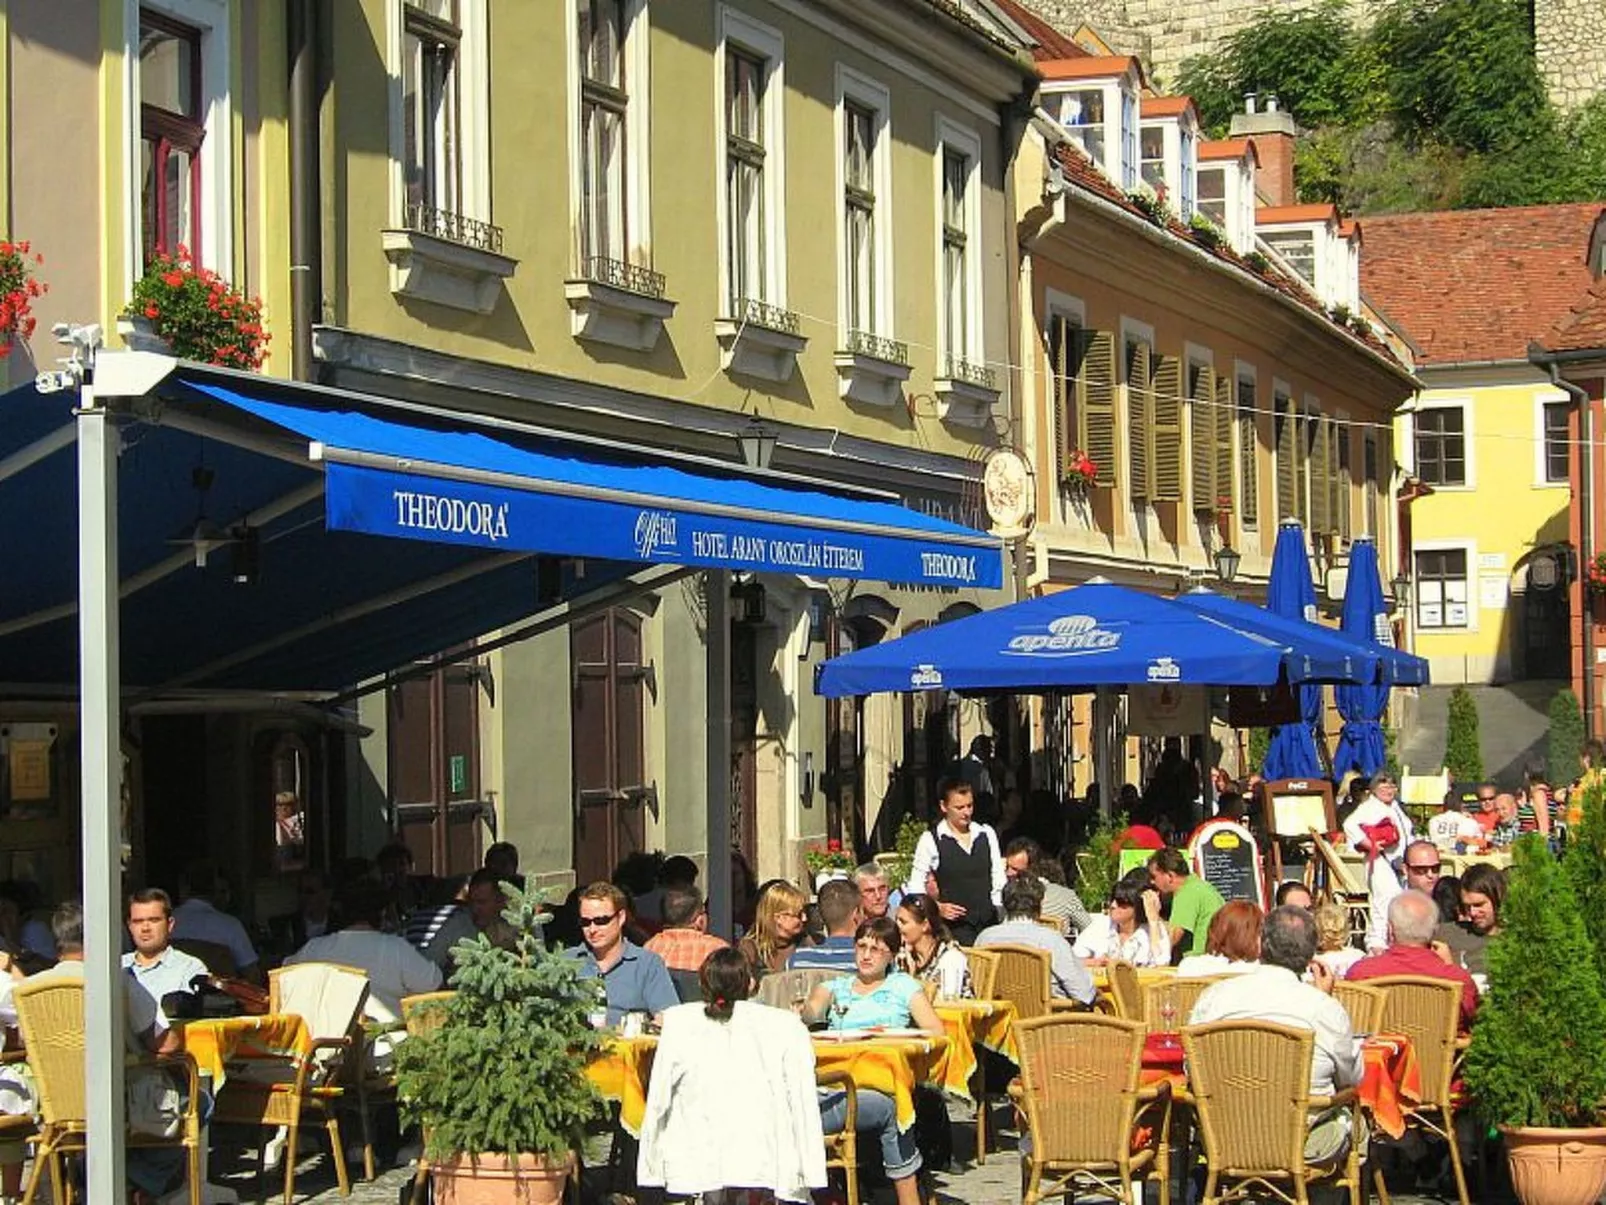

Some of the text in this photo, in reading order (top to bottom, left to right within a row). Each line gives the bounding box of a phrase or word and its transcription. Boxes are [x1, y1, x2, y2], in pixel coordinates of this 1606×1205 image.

[692, 531, 729, 559] HOTEL
[730, 534, 768, 563] ARANY
[823, 539, 864, 572] ÉTTEREM
